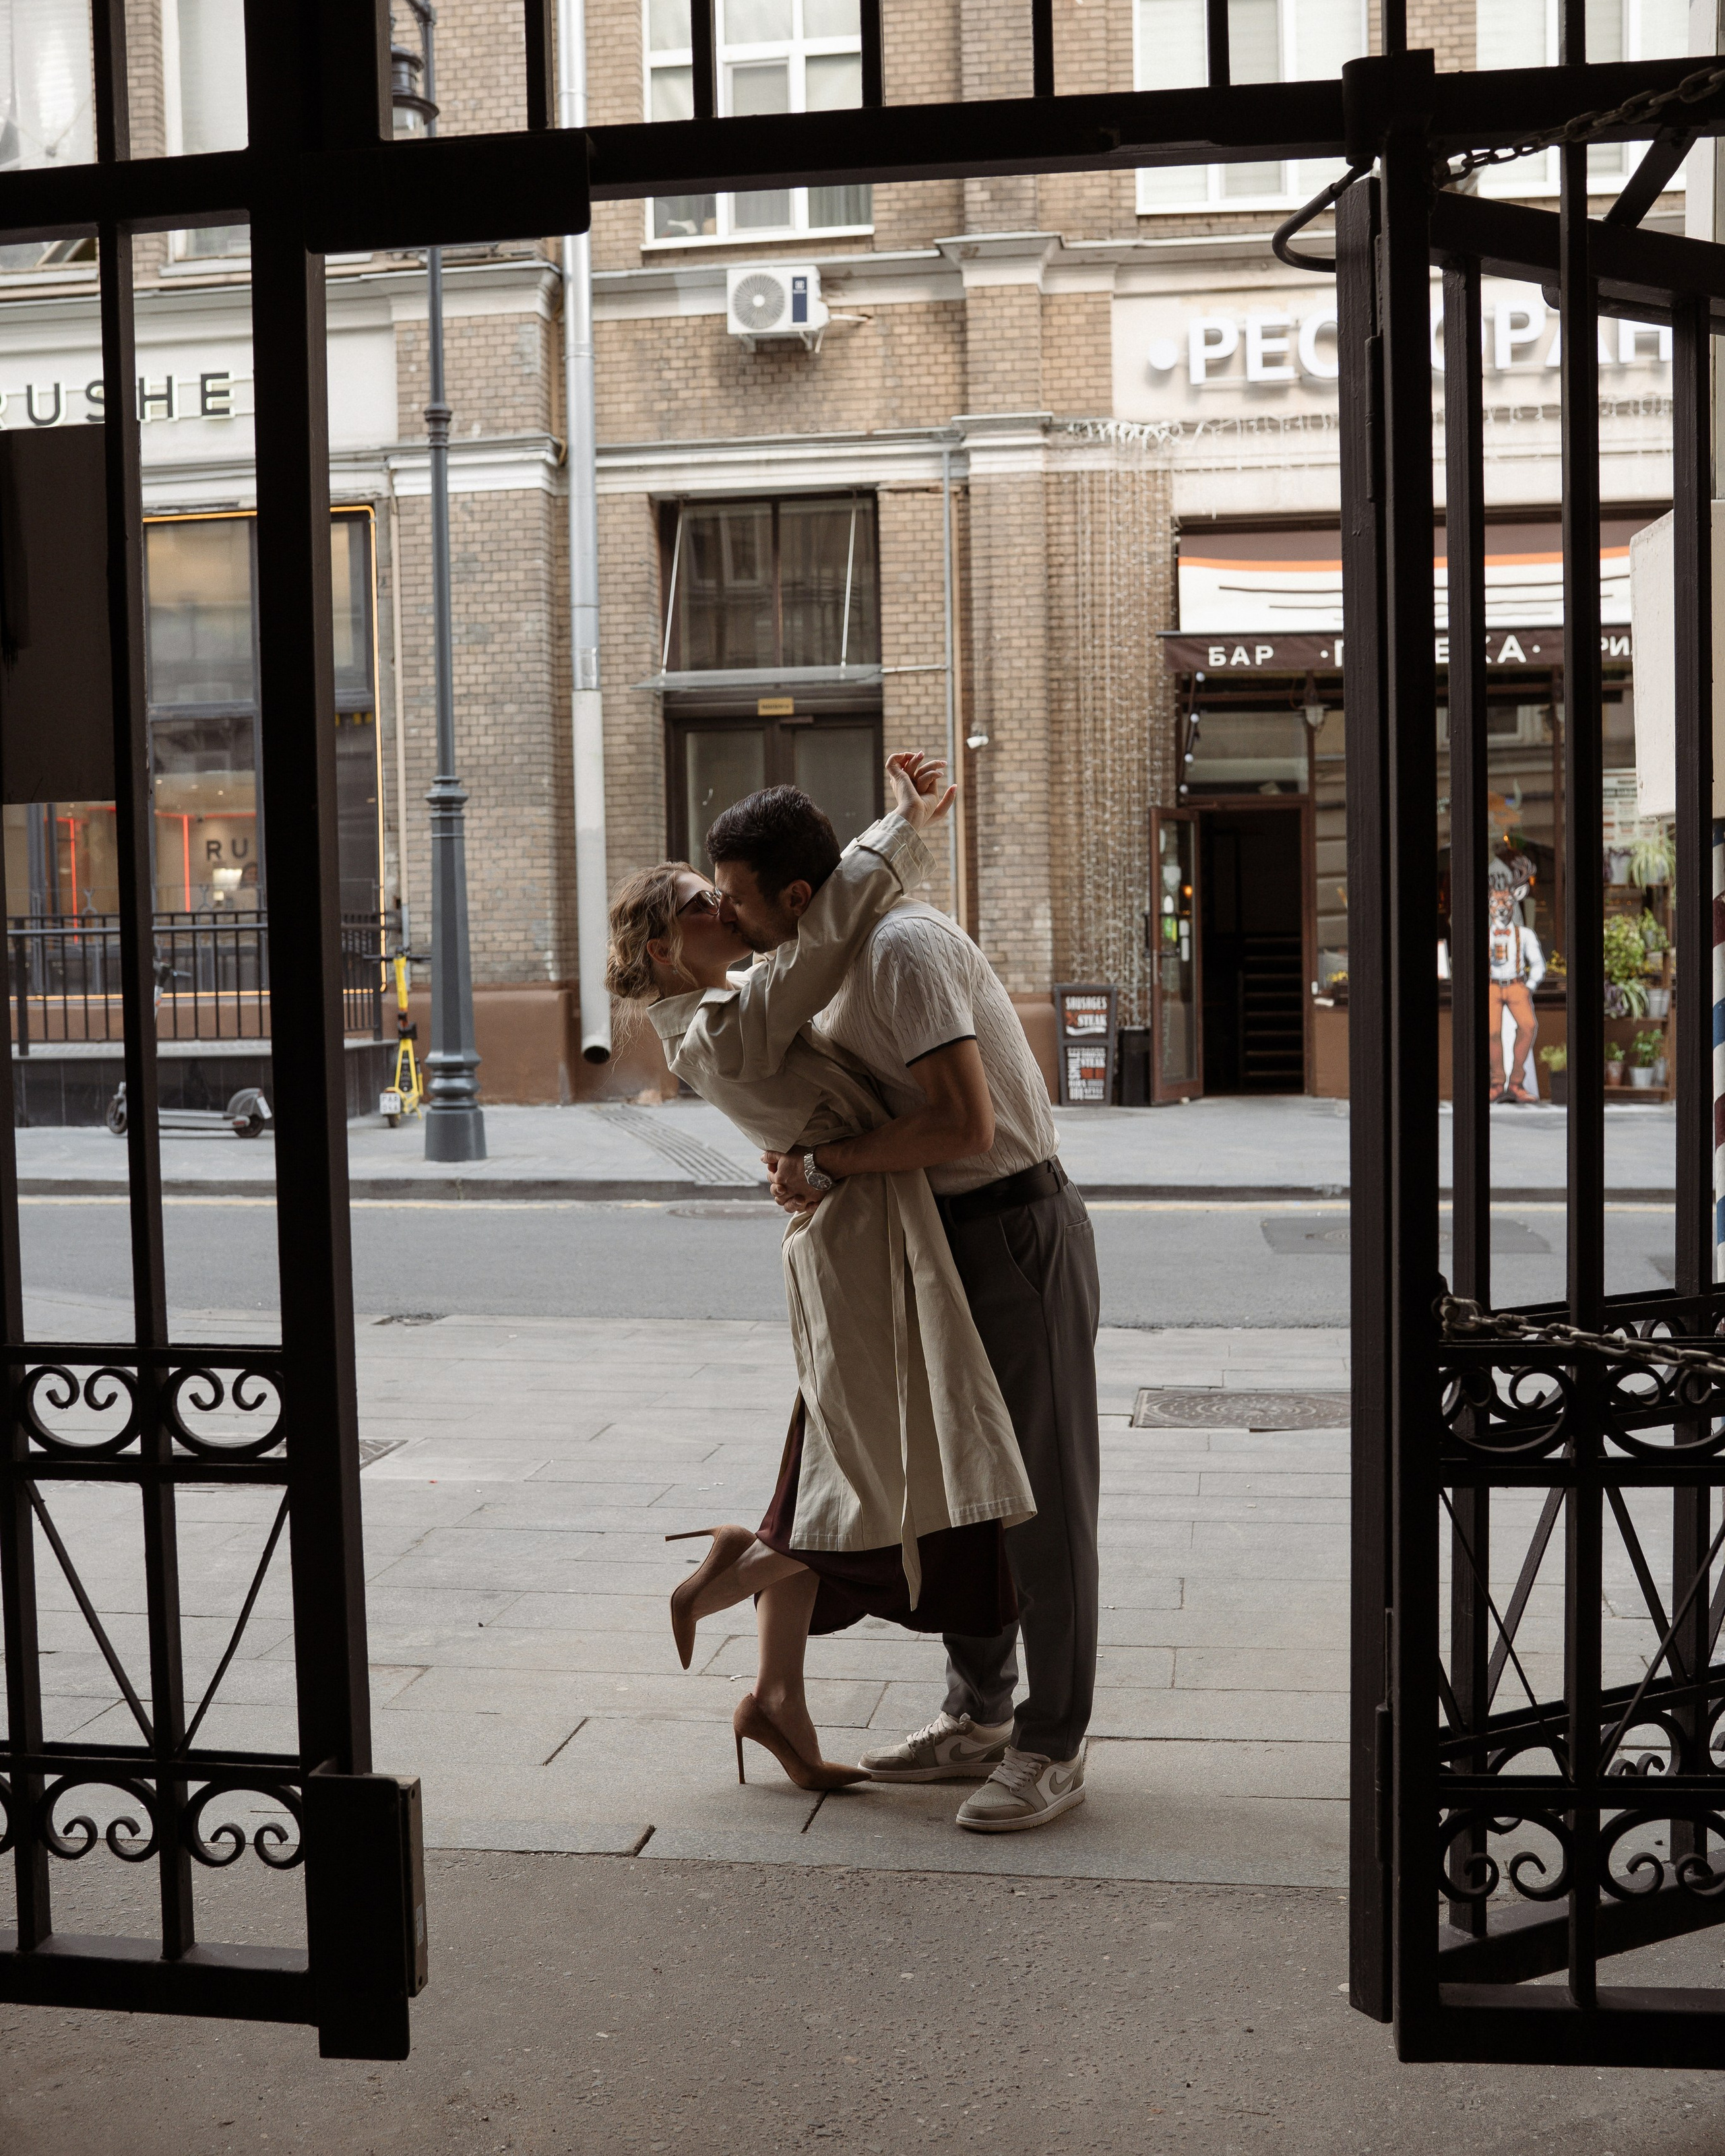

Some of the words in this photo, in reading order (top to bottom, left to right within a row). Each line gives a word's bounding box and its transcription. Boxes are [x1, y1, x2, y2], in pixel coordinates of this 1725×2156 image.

[1189, 300, 1672, 385] РЕСРН
[0, 372, 232, 429] USHE
[1208, 645, 1274, 667] БАР
[1065, 996, 1107, 1010] SAUSAGES
[1077, 1014, 1107, 1027] STEAK
